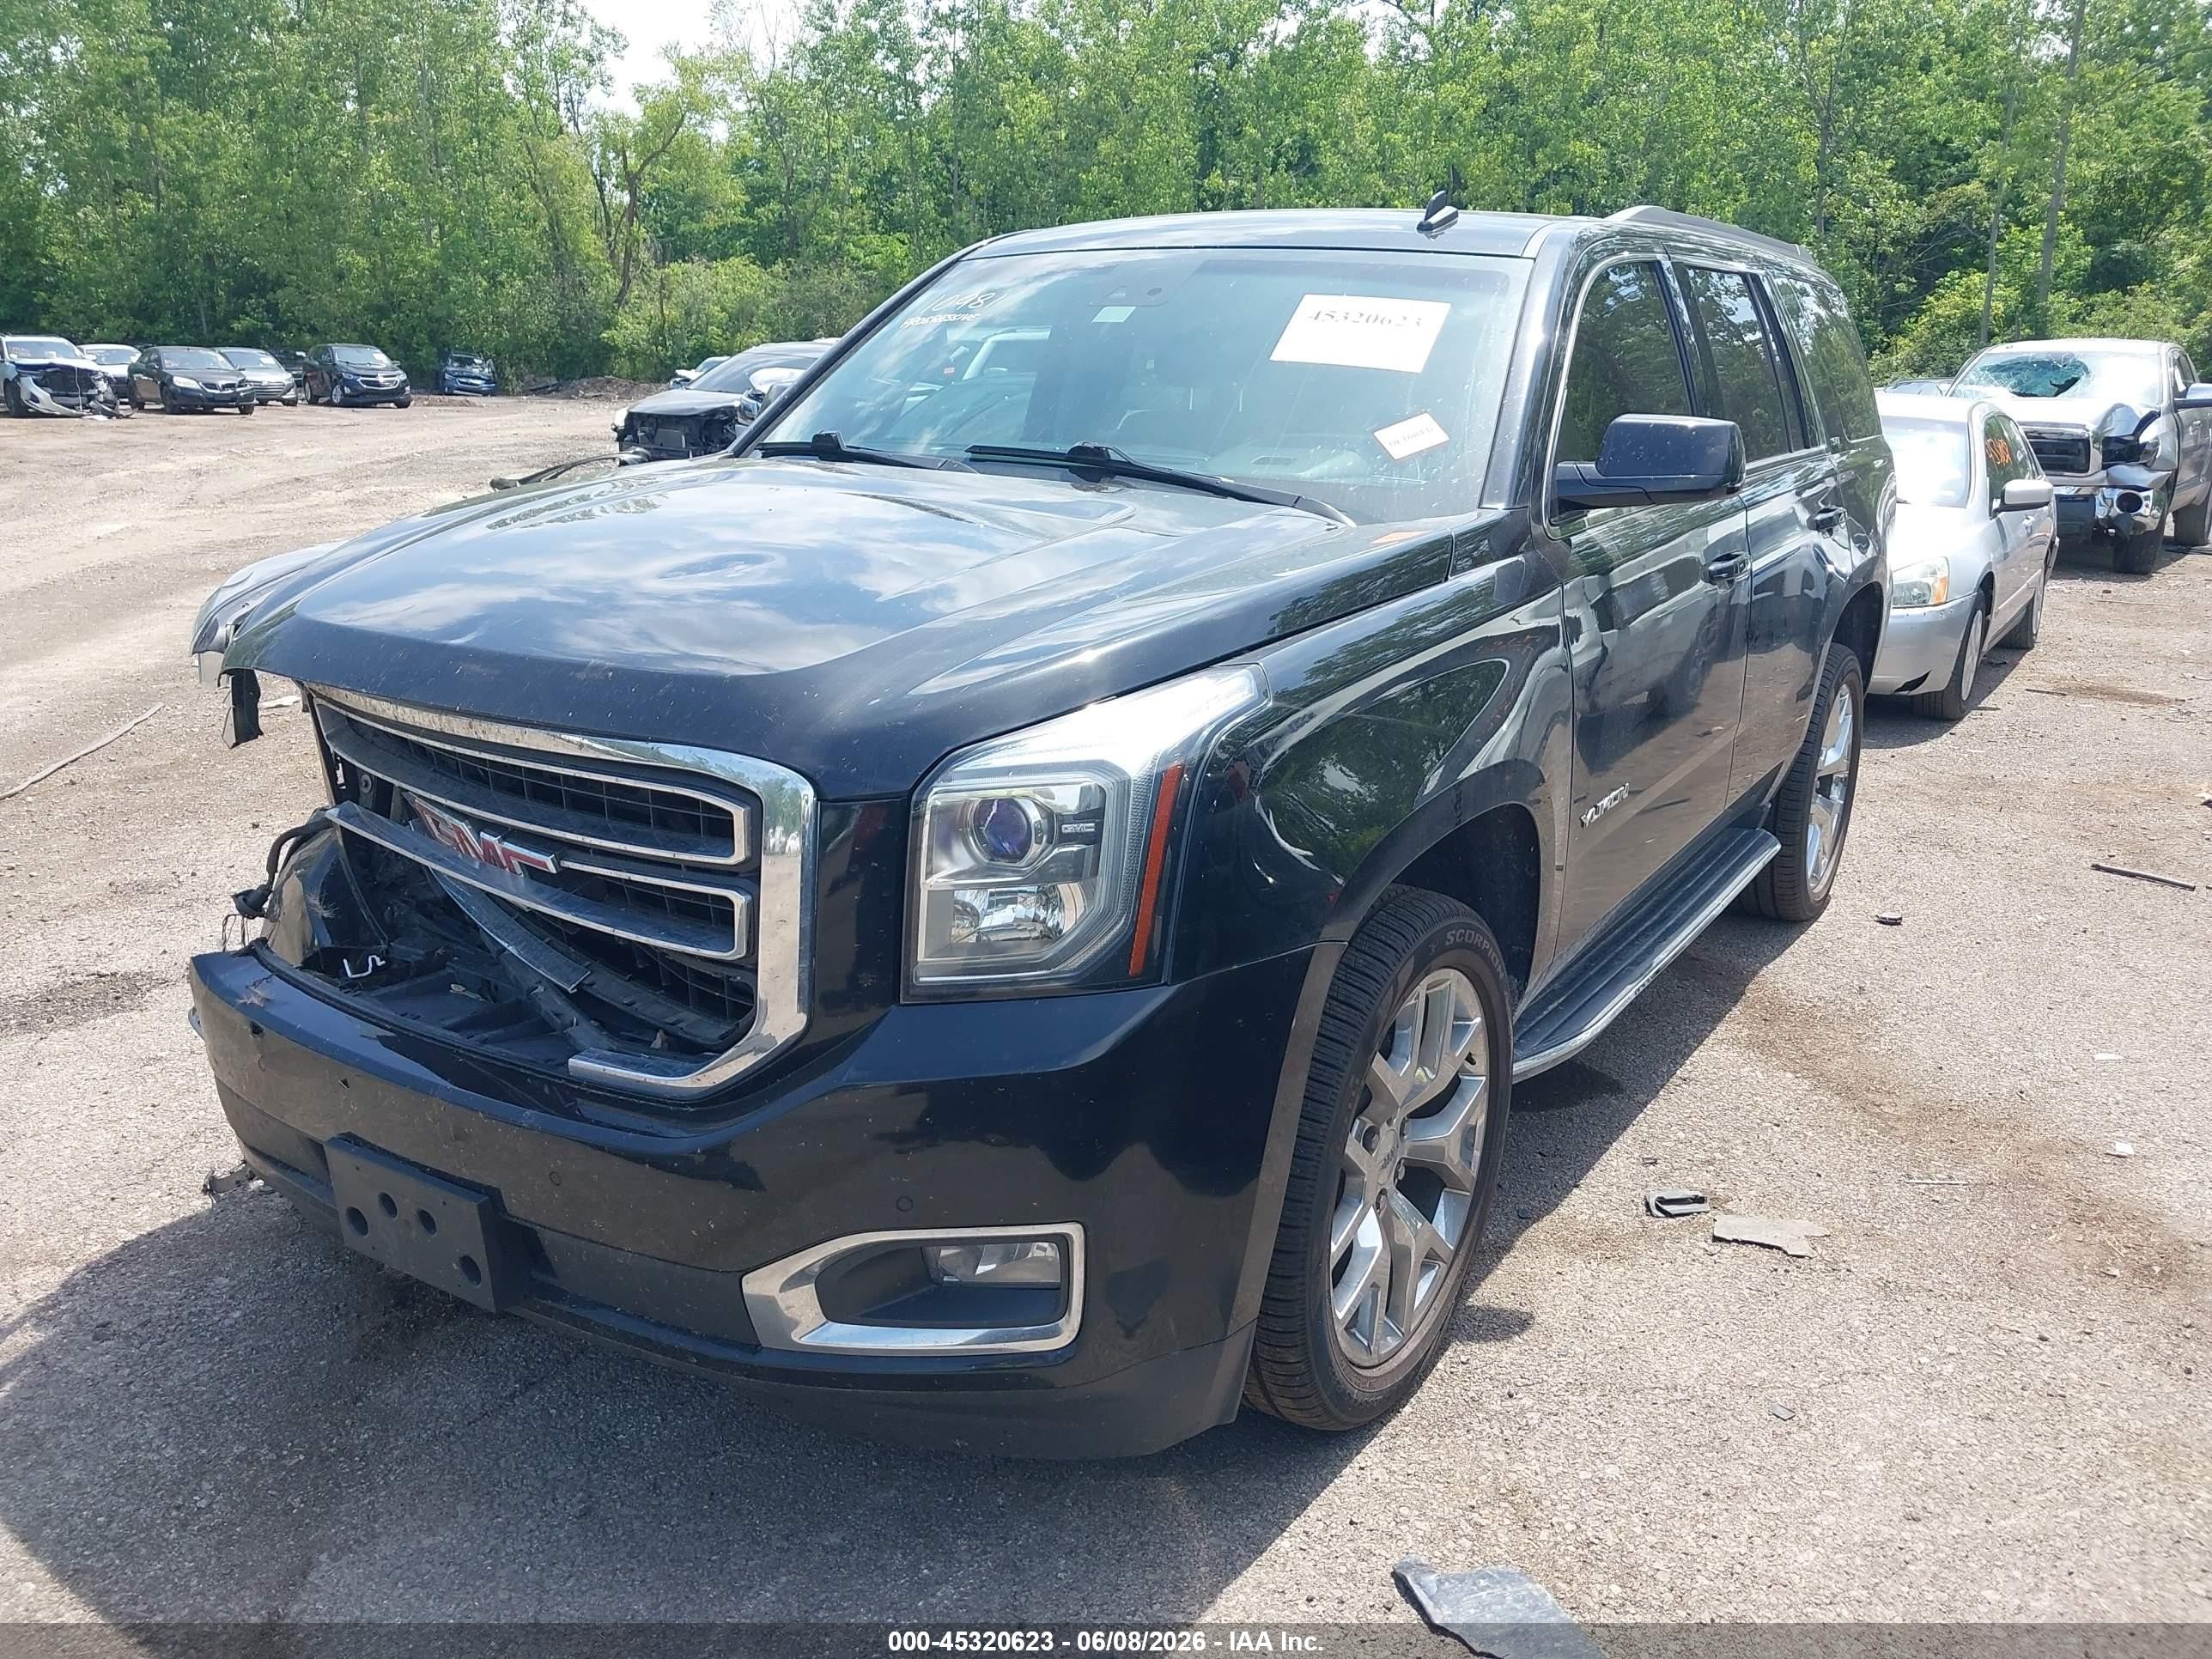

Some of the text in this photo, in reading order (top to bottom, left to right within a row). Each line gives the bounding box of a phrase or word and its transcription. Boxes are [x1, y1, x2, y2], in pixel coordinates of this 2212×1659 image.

[920, 290, 1008, 315] 10981
[1307, 309, 1423, 327] 45320623
[1580, 782, 1630, 829] YUKON
[1061, 822, 1096, 835] GMC
